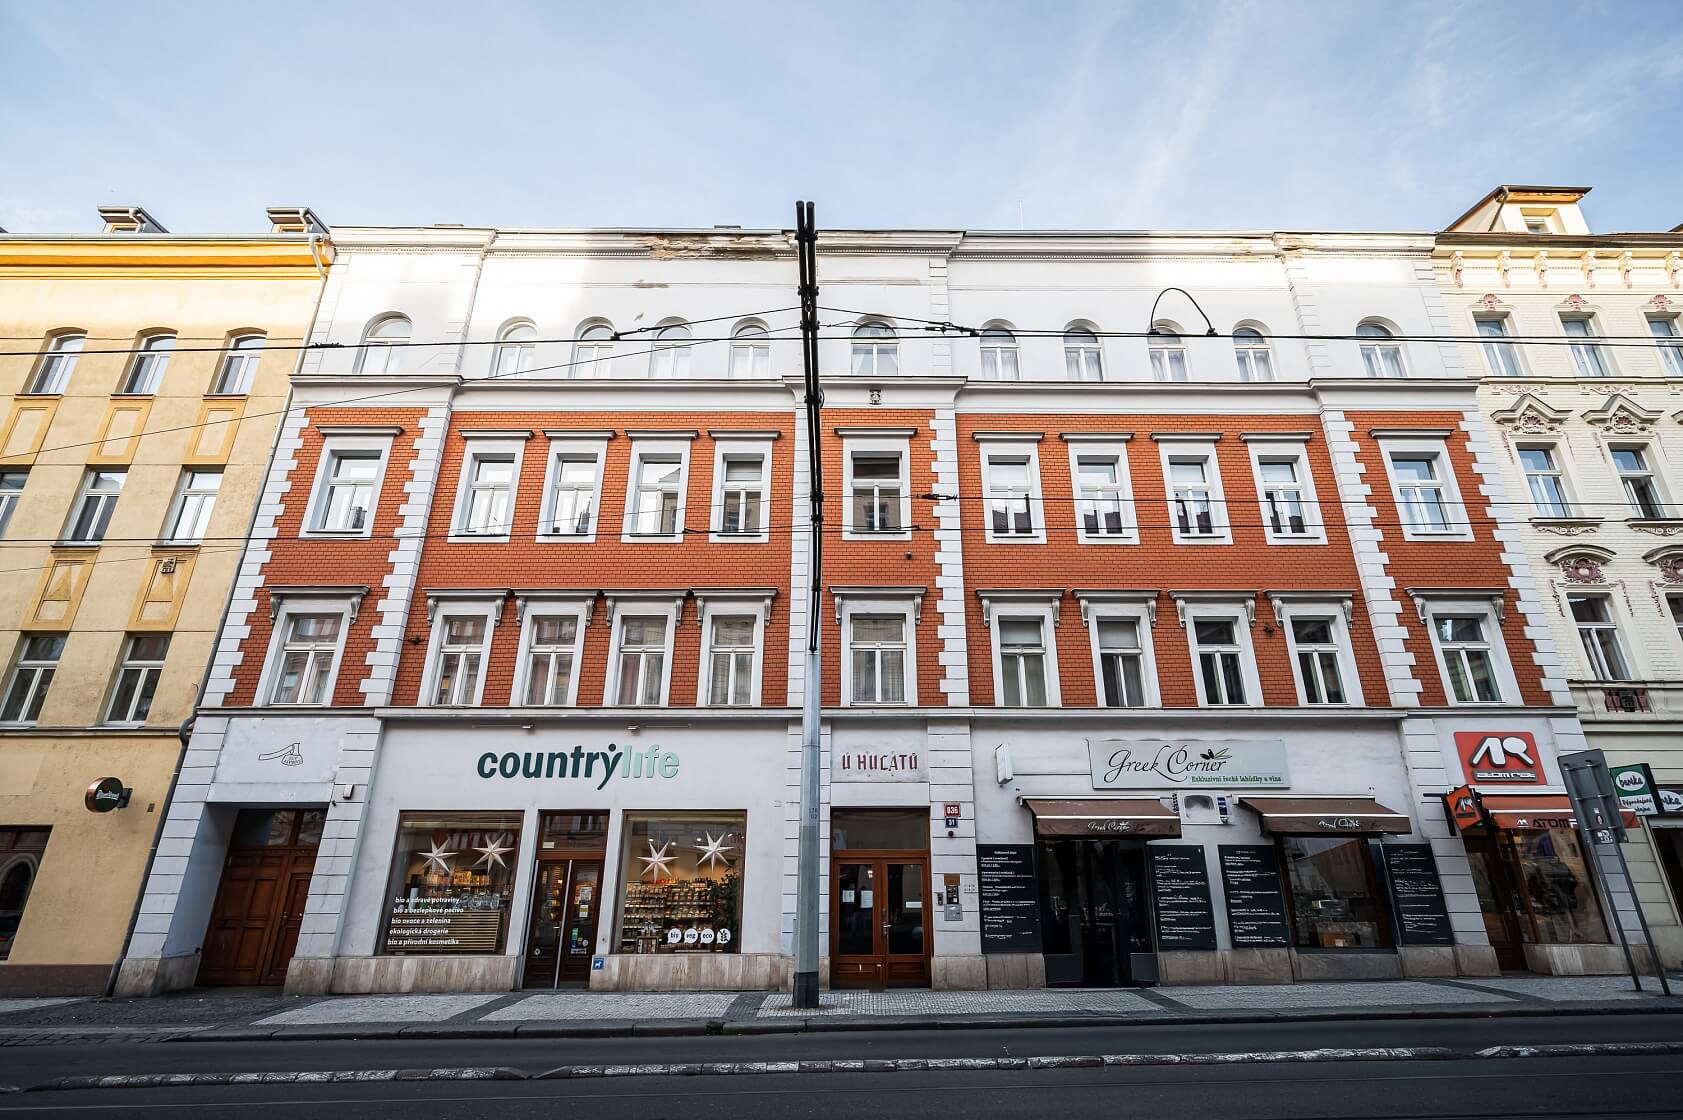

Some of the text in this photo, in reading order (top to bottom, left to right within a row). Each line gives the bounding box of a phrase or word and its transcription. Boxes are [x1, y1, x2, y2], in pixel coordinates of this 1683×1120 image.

[1103, 744, 1227, 783] Greek Corner
[431, 896, 460, 904] potraviny
[409, 907, 443, 915] bezlepkové
[444, 907, 464, 915] pečivo
[389, 928, 422, 936] ekologická
[403, 938, 428, 947] přírodní
